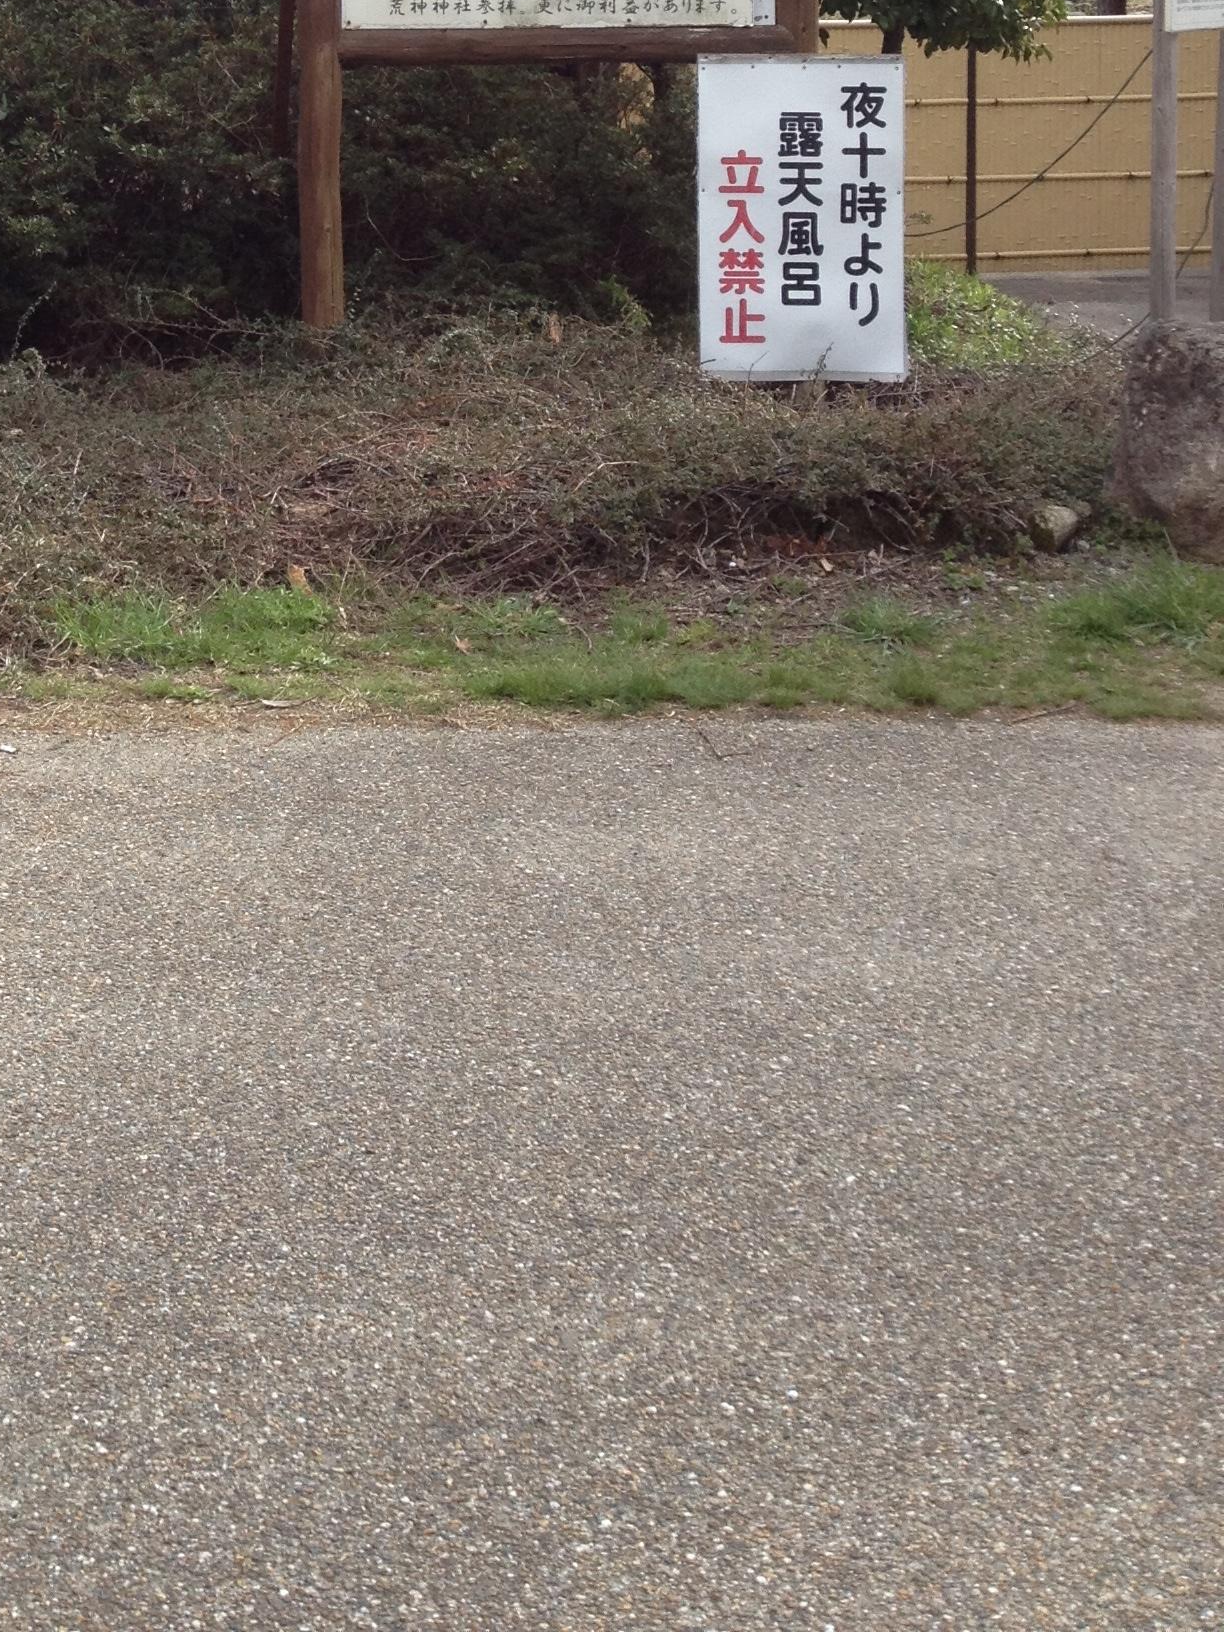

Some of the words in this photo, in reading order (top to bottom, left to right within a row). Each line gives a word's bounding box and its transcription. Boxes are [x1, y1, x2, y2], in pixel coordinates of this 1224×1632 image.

[718, 149, 765, 343] 立入禁止
[777, 111, 824, 306] 露天風呂
[840, 82, 886, 326] 夜十時より
